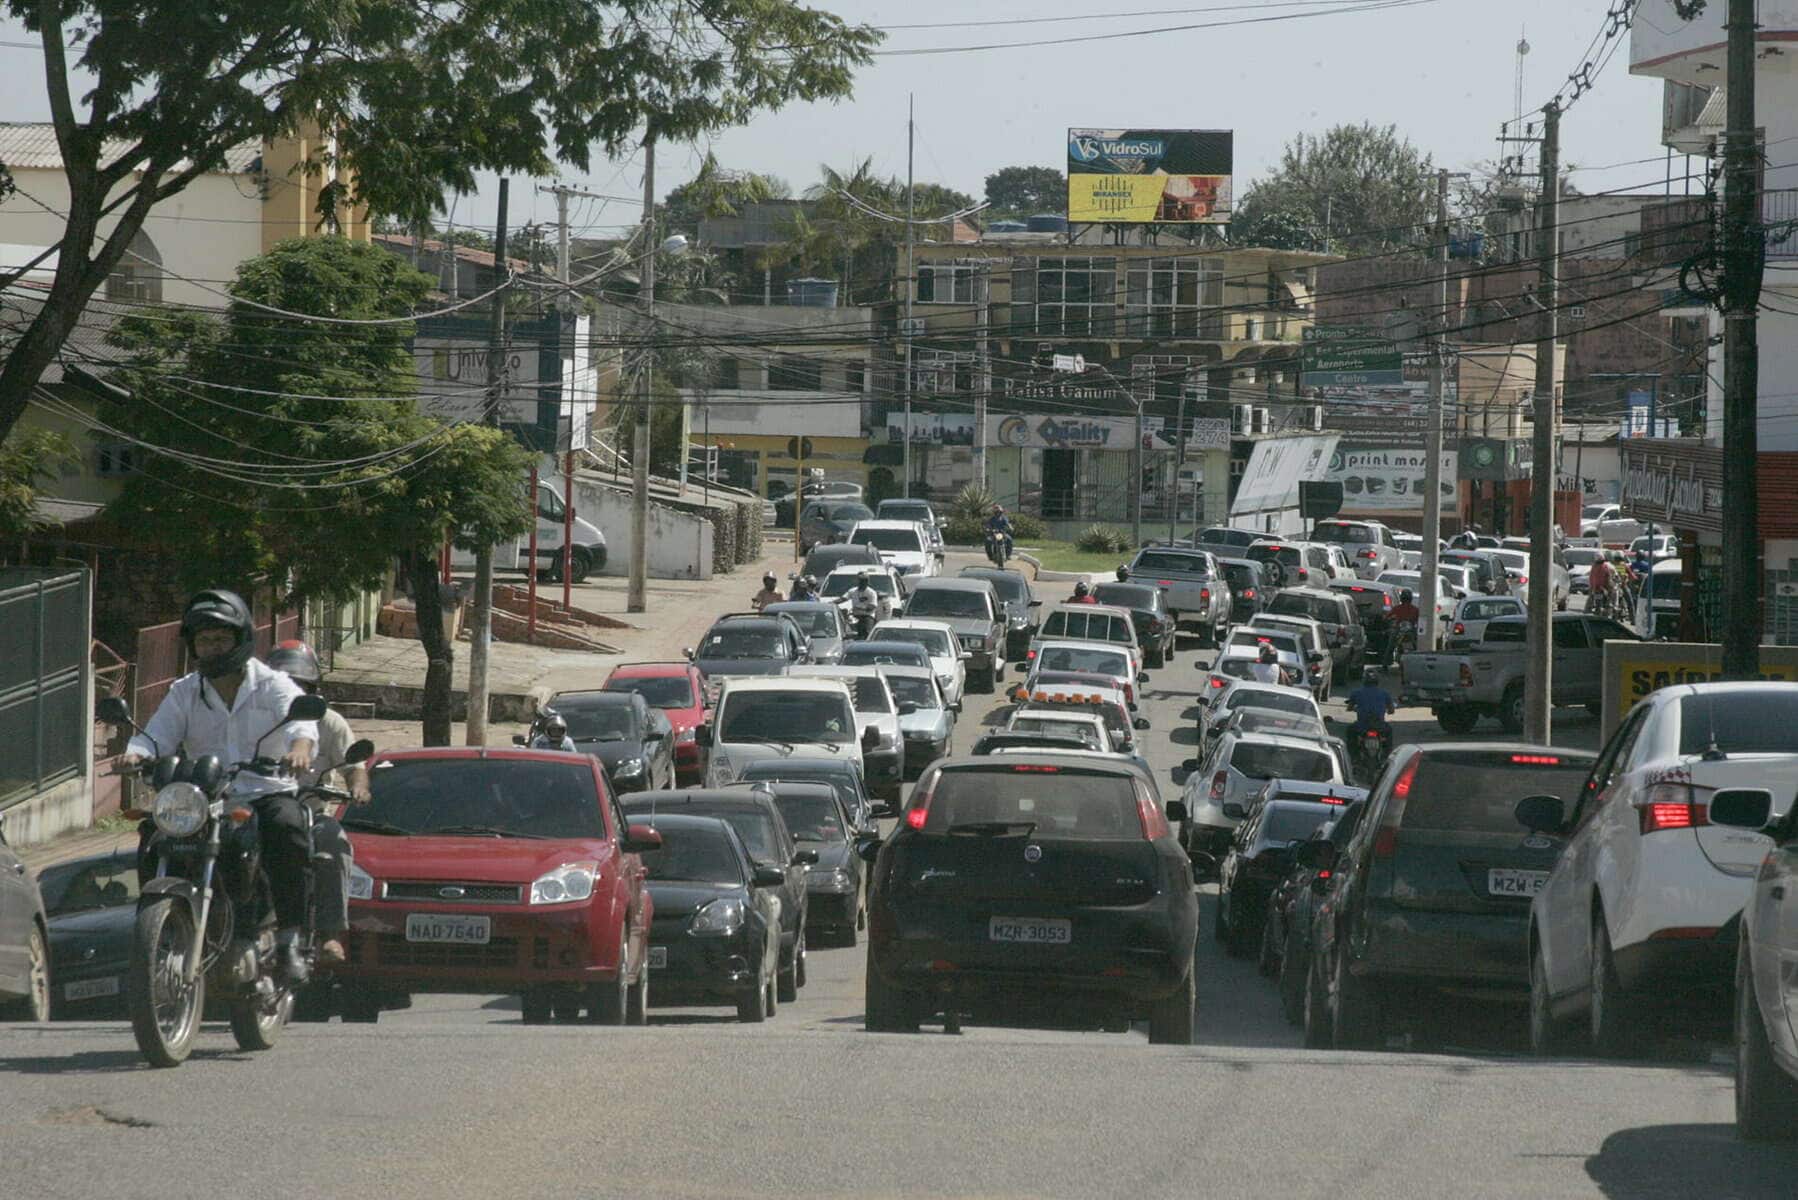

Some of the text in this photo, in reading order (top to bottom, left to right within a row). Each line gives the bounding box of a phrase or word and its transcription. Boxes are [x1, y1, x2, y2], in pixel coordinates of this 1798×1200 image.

[1075, 137, 1162, 159] VS VidroSul
[447, 348, 521, 380] Univo
[1317, 359, 1365, 370] Aeroporto
[1335, 374, 1368, 383] Centro
[1038, 417, 1112, 446] Quality
[1348, 452, 1450, 467] print masr
[1631, 667, 1723, 695] SAÍ
[1494, 877, 1549, 893] MZW-5
